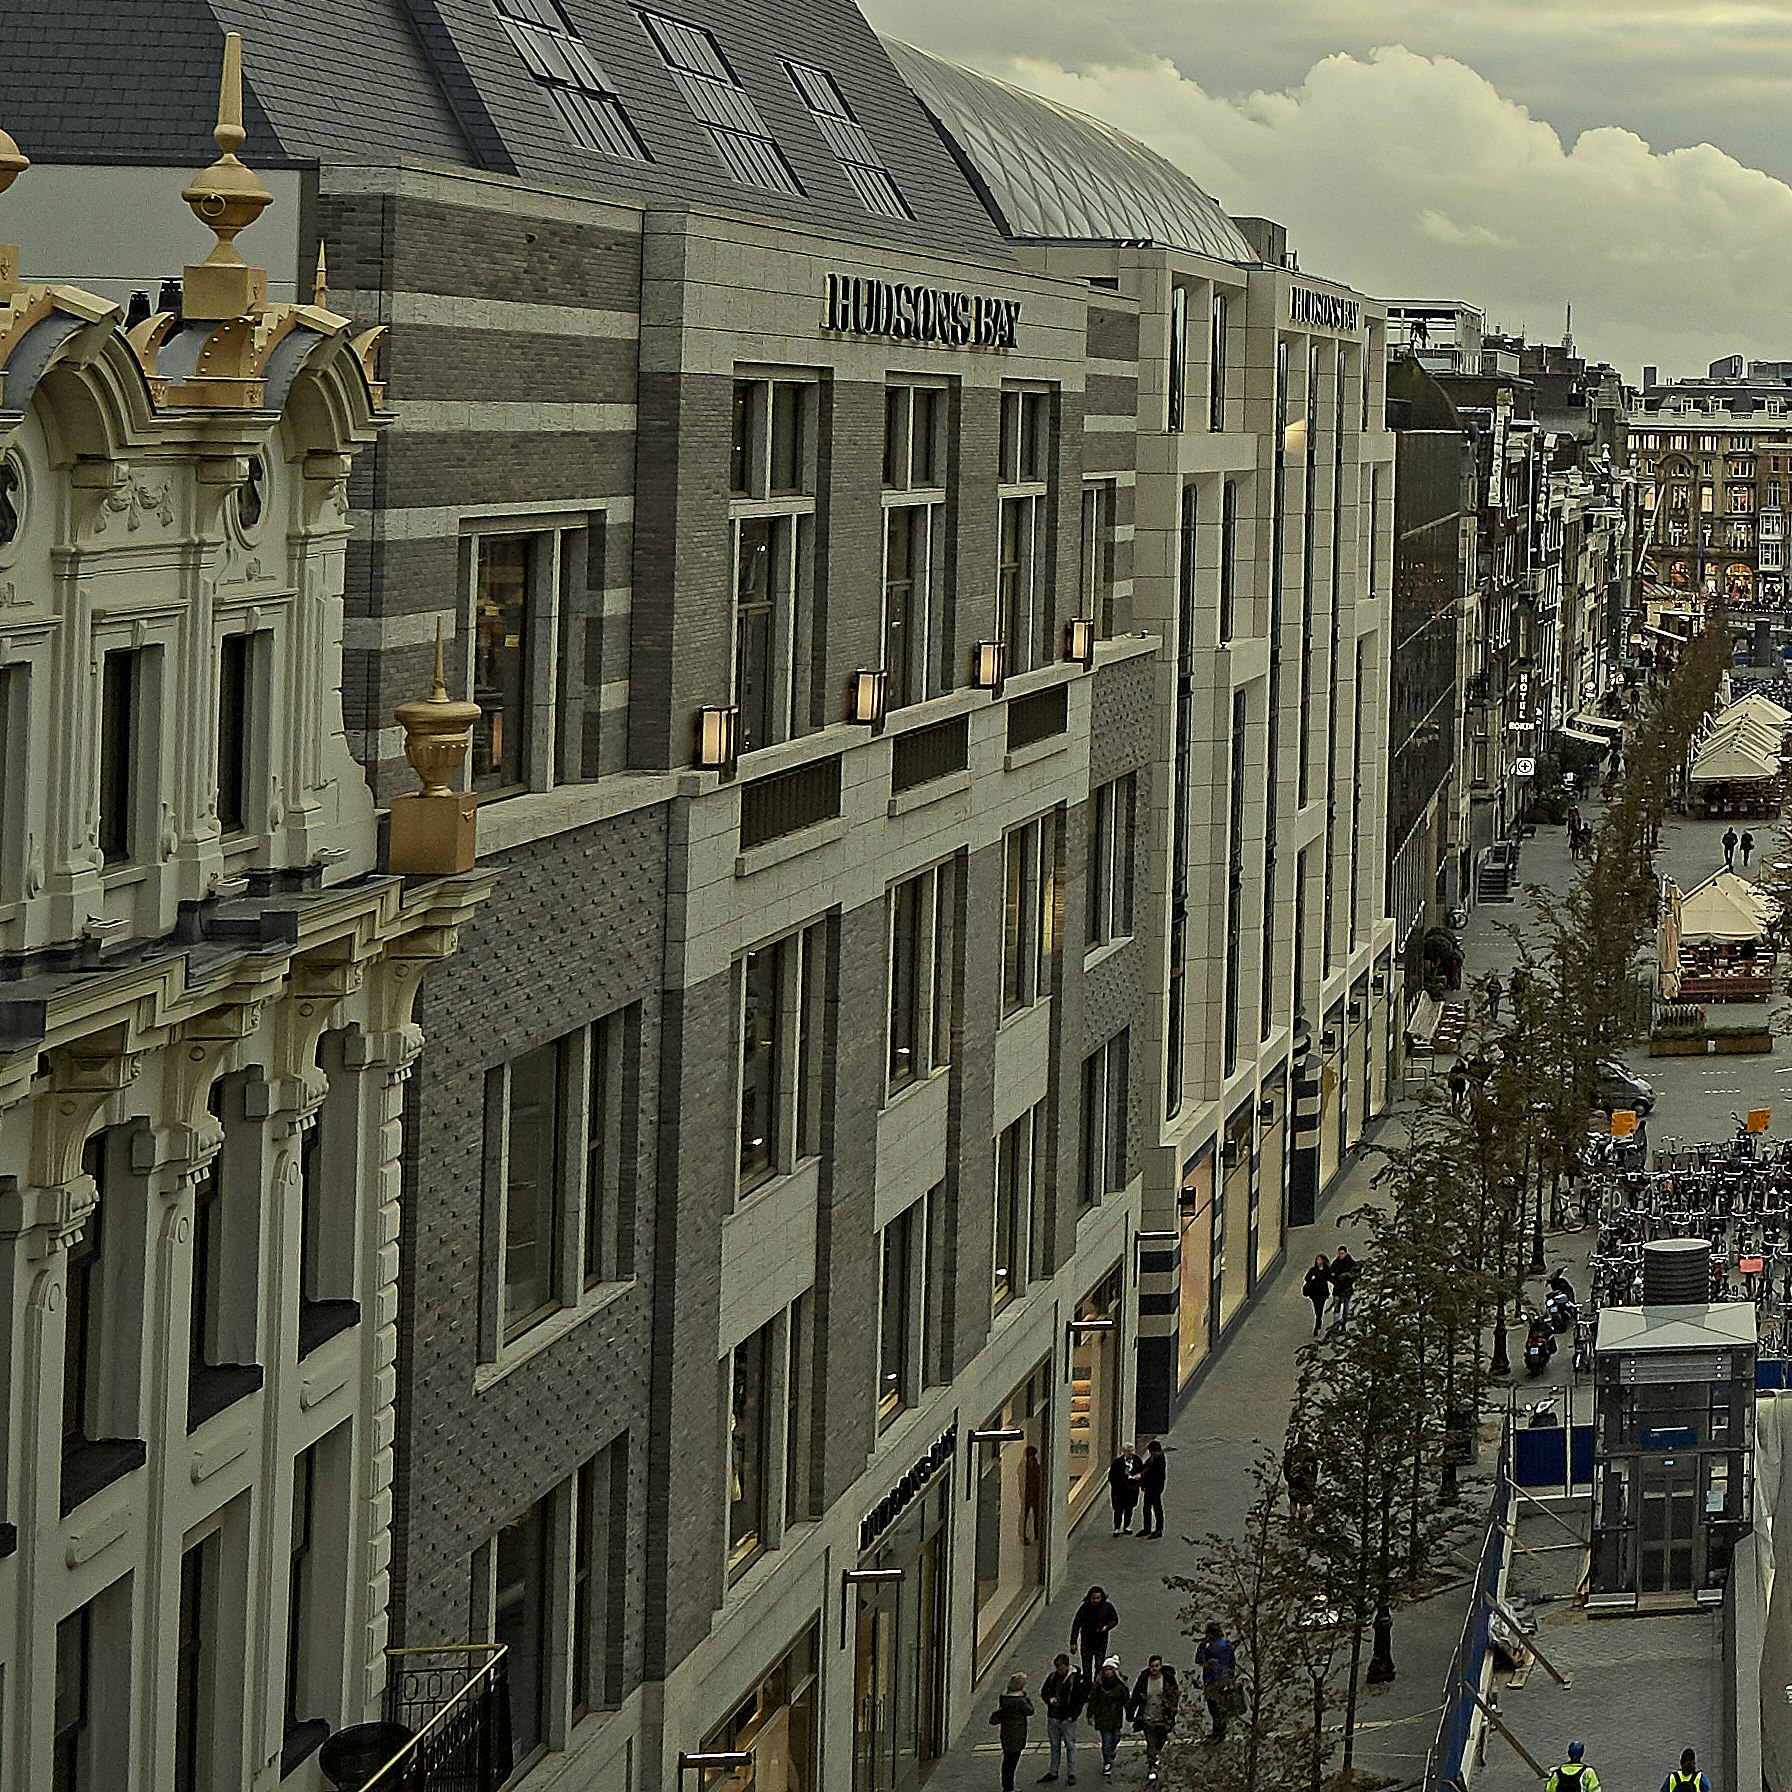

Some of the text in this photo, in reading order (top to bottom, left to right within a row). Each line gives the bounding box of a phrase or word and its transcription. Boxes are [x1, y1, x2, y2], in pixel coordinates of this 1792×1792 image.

[970, 295, 1022, 349] BAY
[1340, 299, 1360, 331] BAY
[1519, 673, 1528, 719] HOTEL
